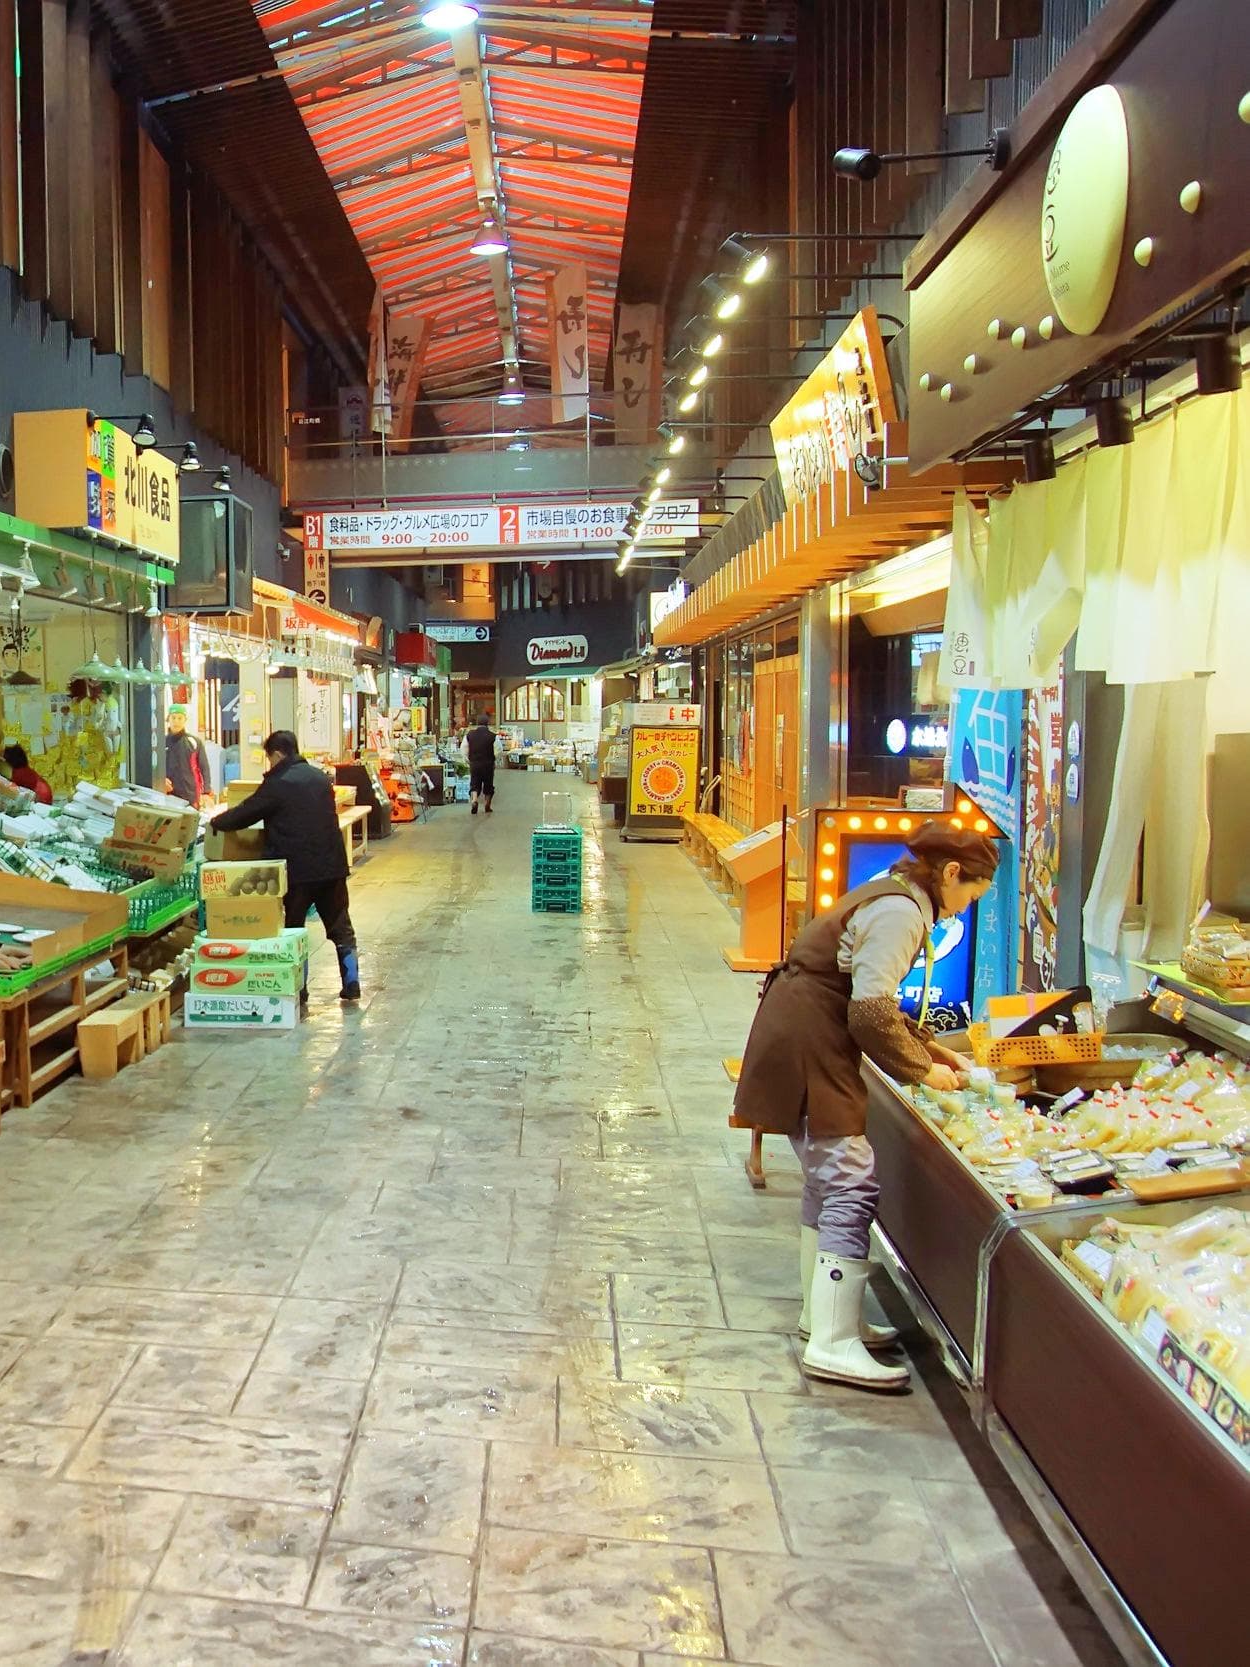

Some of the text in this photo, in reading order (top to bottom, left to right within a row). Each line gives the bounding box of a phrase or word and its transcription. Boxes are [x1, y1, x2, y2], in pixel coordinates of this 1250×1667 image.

[124, 455, 171, 522] 北川食品
[329, 512, 489, 533] 食料品・ドラッグ・グルメ広場のフロア
[502, 508, 517, 529] 2
[526, 504, 692, 526] 市場自慢のお食事フロア
[305, 514, 322, 537] B1
[526, 529, 569, 540] 営業時間
[308, 537, 320, 549] 階
[329, 535, 372, 546] 営業時間
[504, 529, 516, 543] 階
[530, 642, 573, 661] Diamond
[636, 803, 674, 815] 地下1階
